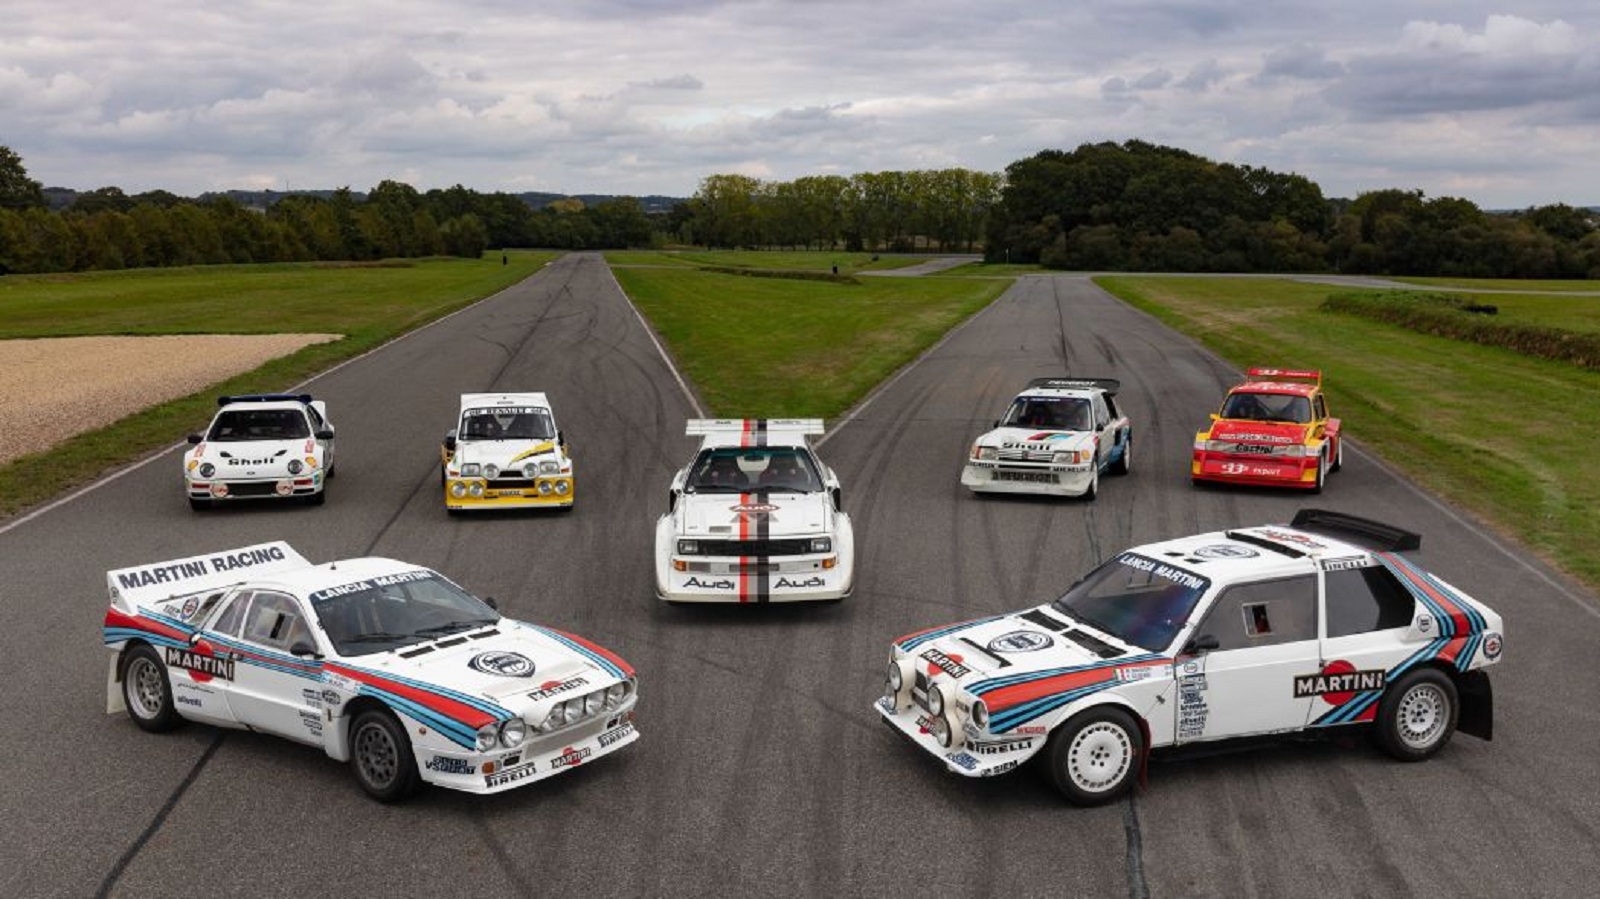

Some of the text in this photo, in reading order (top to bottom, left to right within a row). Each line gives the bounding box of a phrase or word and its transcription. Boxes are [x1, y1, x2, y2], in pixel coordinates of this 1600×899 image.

[1003, 442, 1050, 451] Shell
[1235, 443, 1274, 454] Castrol
[228, 458, 275, 466] Shell
[117, 546, 285, 589] MARTINI RACING
[1119, 553, 1205, 589] LANCIA MARTINI
[315, 569, 432, 600] LANCIA MARTINI
[683, 576, 735, 589] Audi
[774, 576, 826, 589] Audi
[168, 651, 234, 680] MARTINI
[921, 649, 970, 678] MARTINI
[1296, 672, 1384, 695] MARTINI
[967, 738, 1033, 755] PIRELLI
[551, 747, 592, 769] MARTINI
[484, 762, 537, 788] PIRELLI
